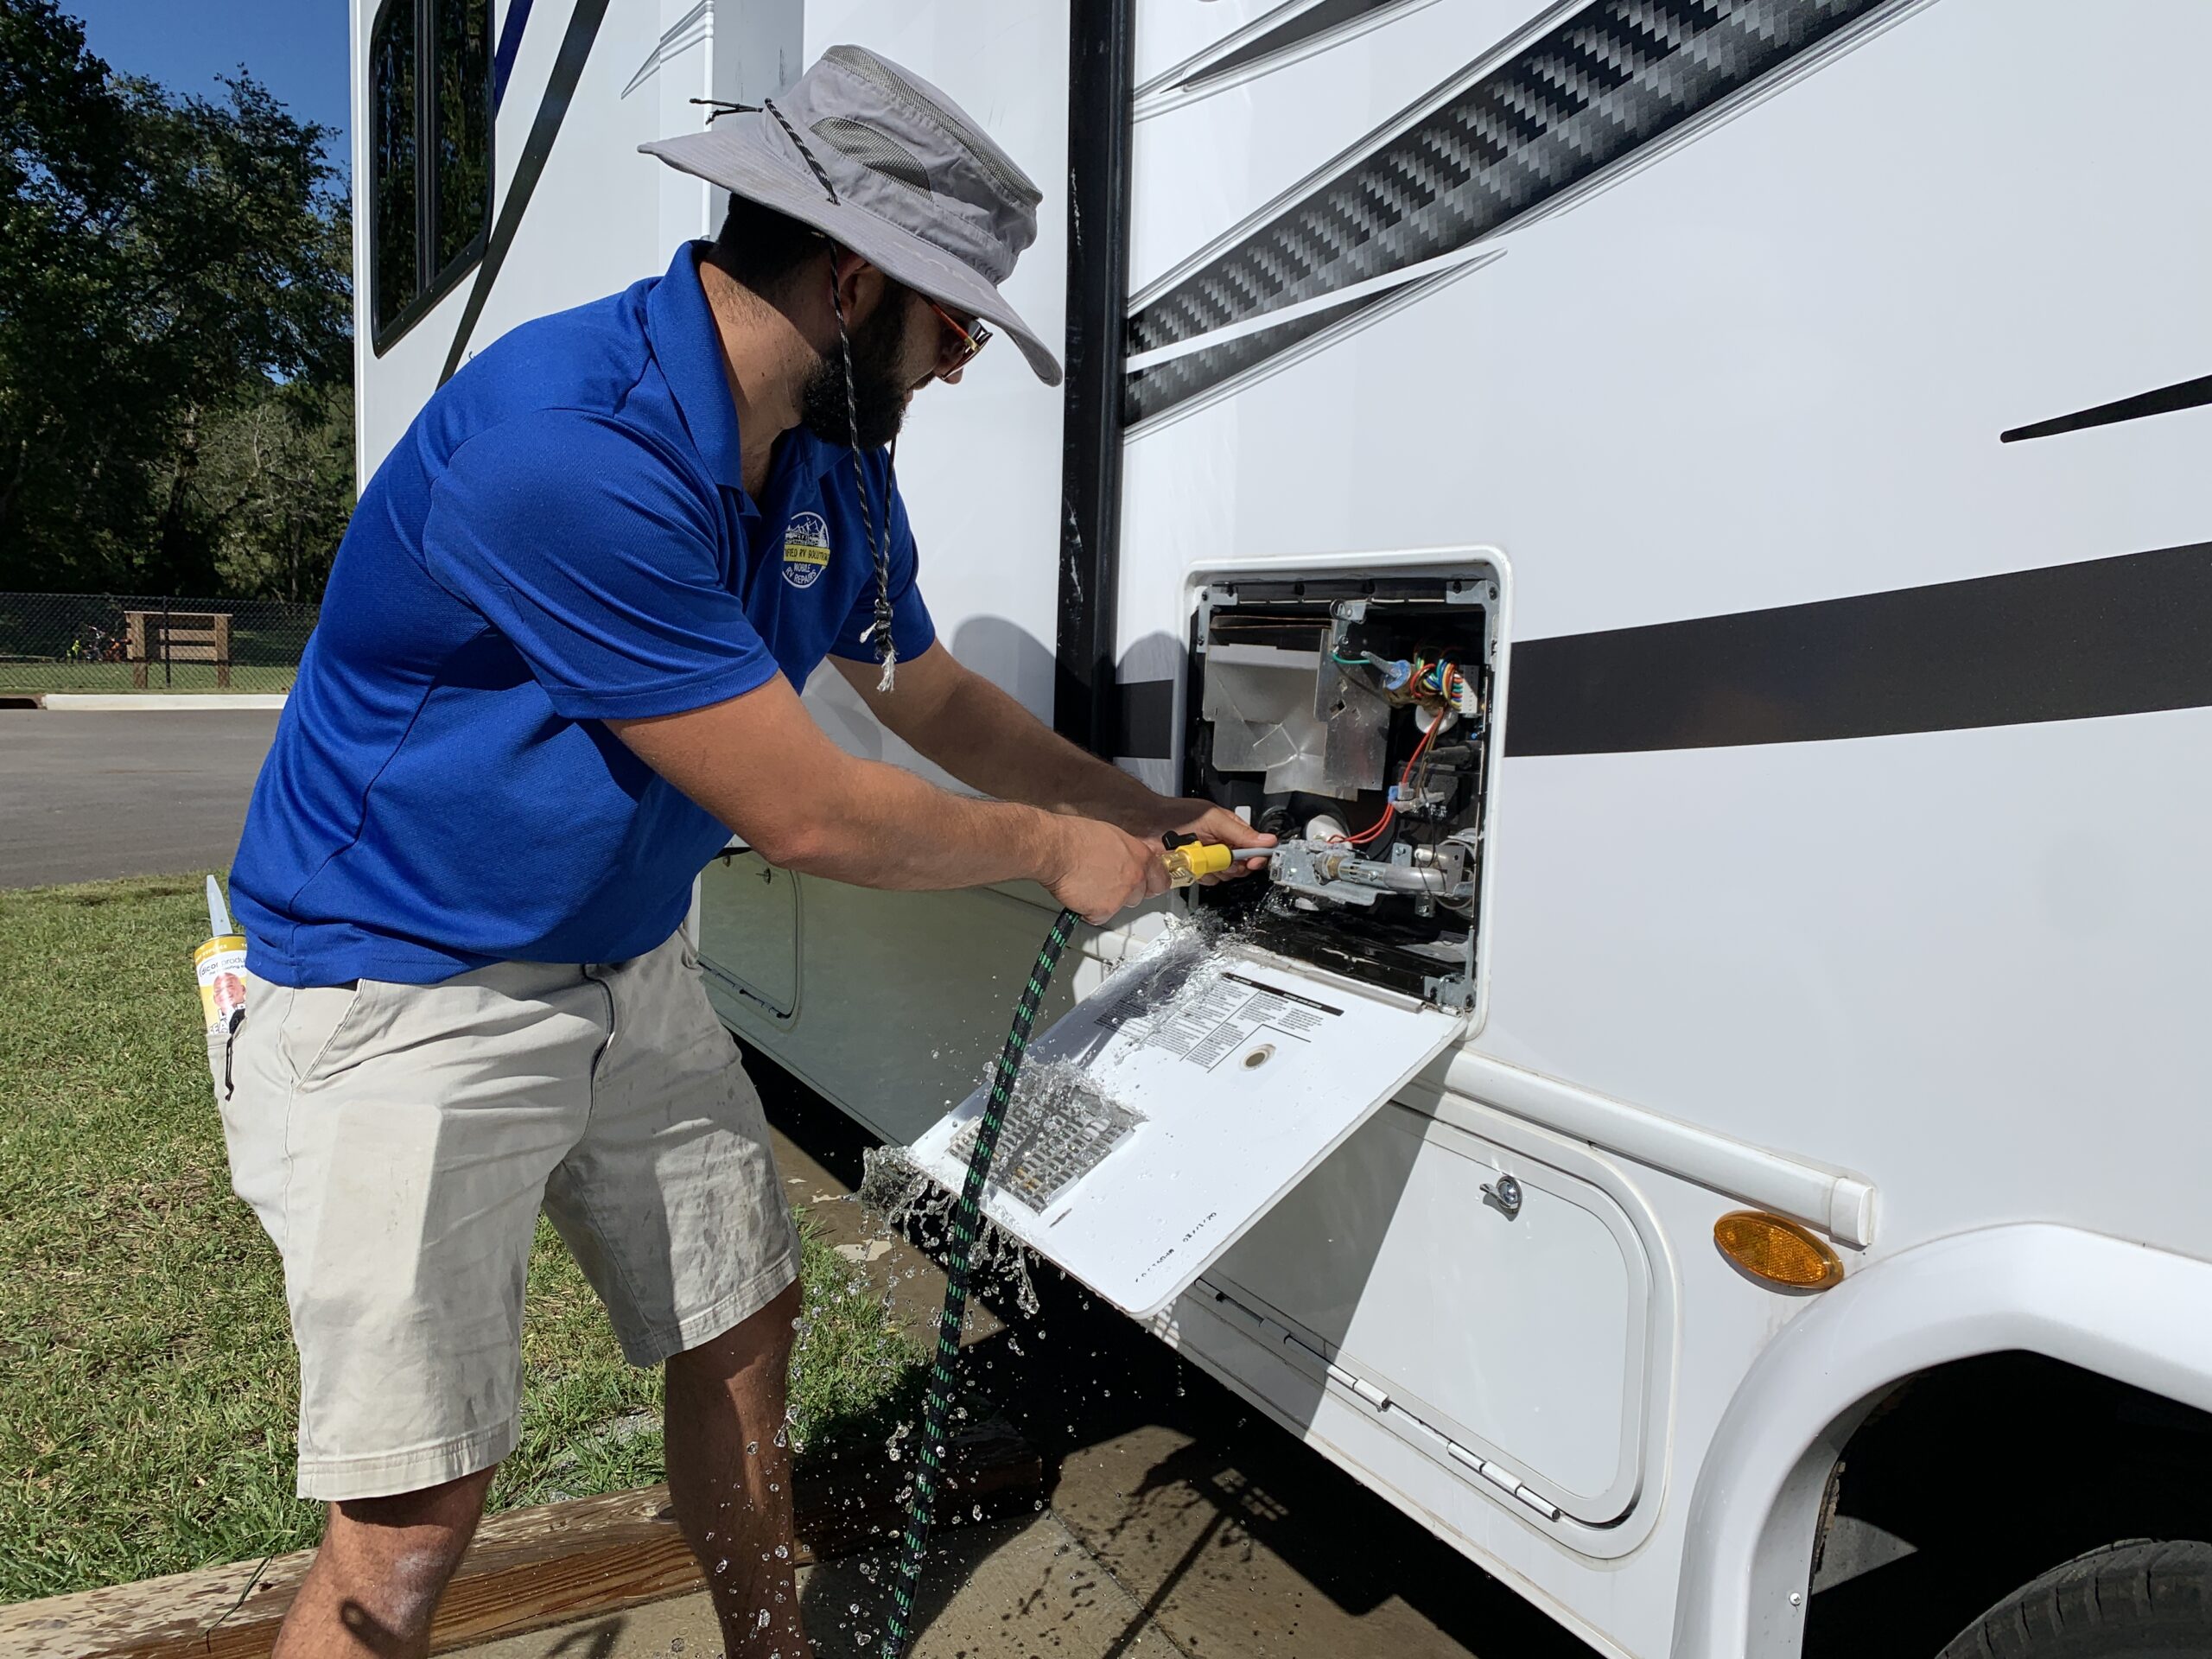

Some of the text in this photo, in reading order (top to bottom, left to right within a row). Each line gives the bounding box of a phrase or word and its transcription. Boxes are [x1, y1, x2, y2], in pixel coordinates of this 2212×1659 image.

[799, 549, 807, 558] RV
[794, 563, 811, 572] MOBILE
[785, 566, 817, 584] RV REPAIRS
[201, 962, 219, 976] dicor
